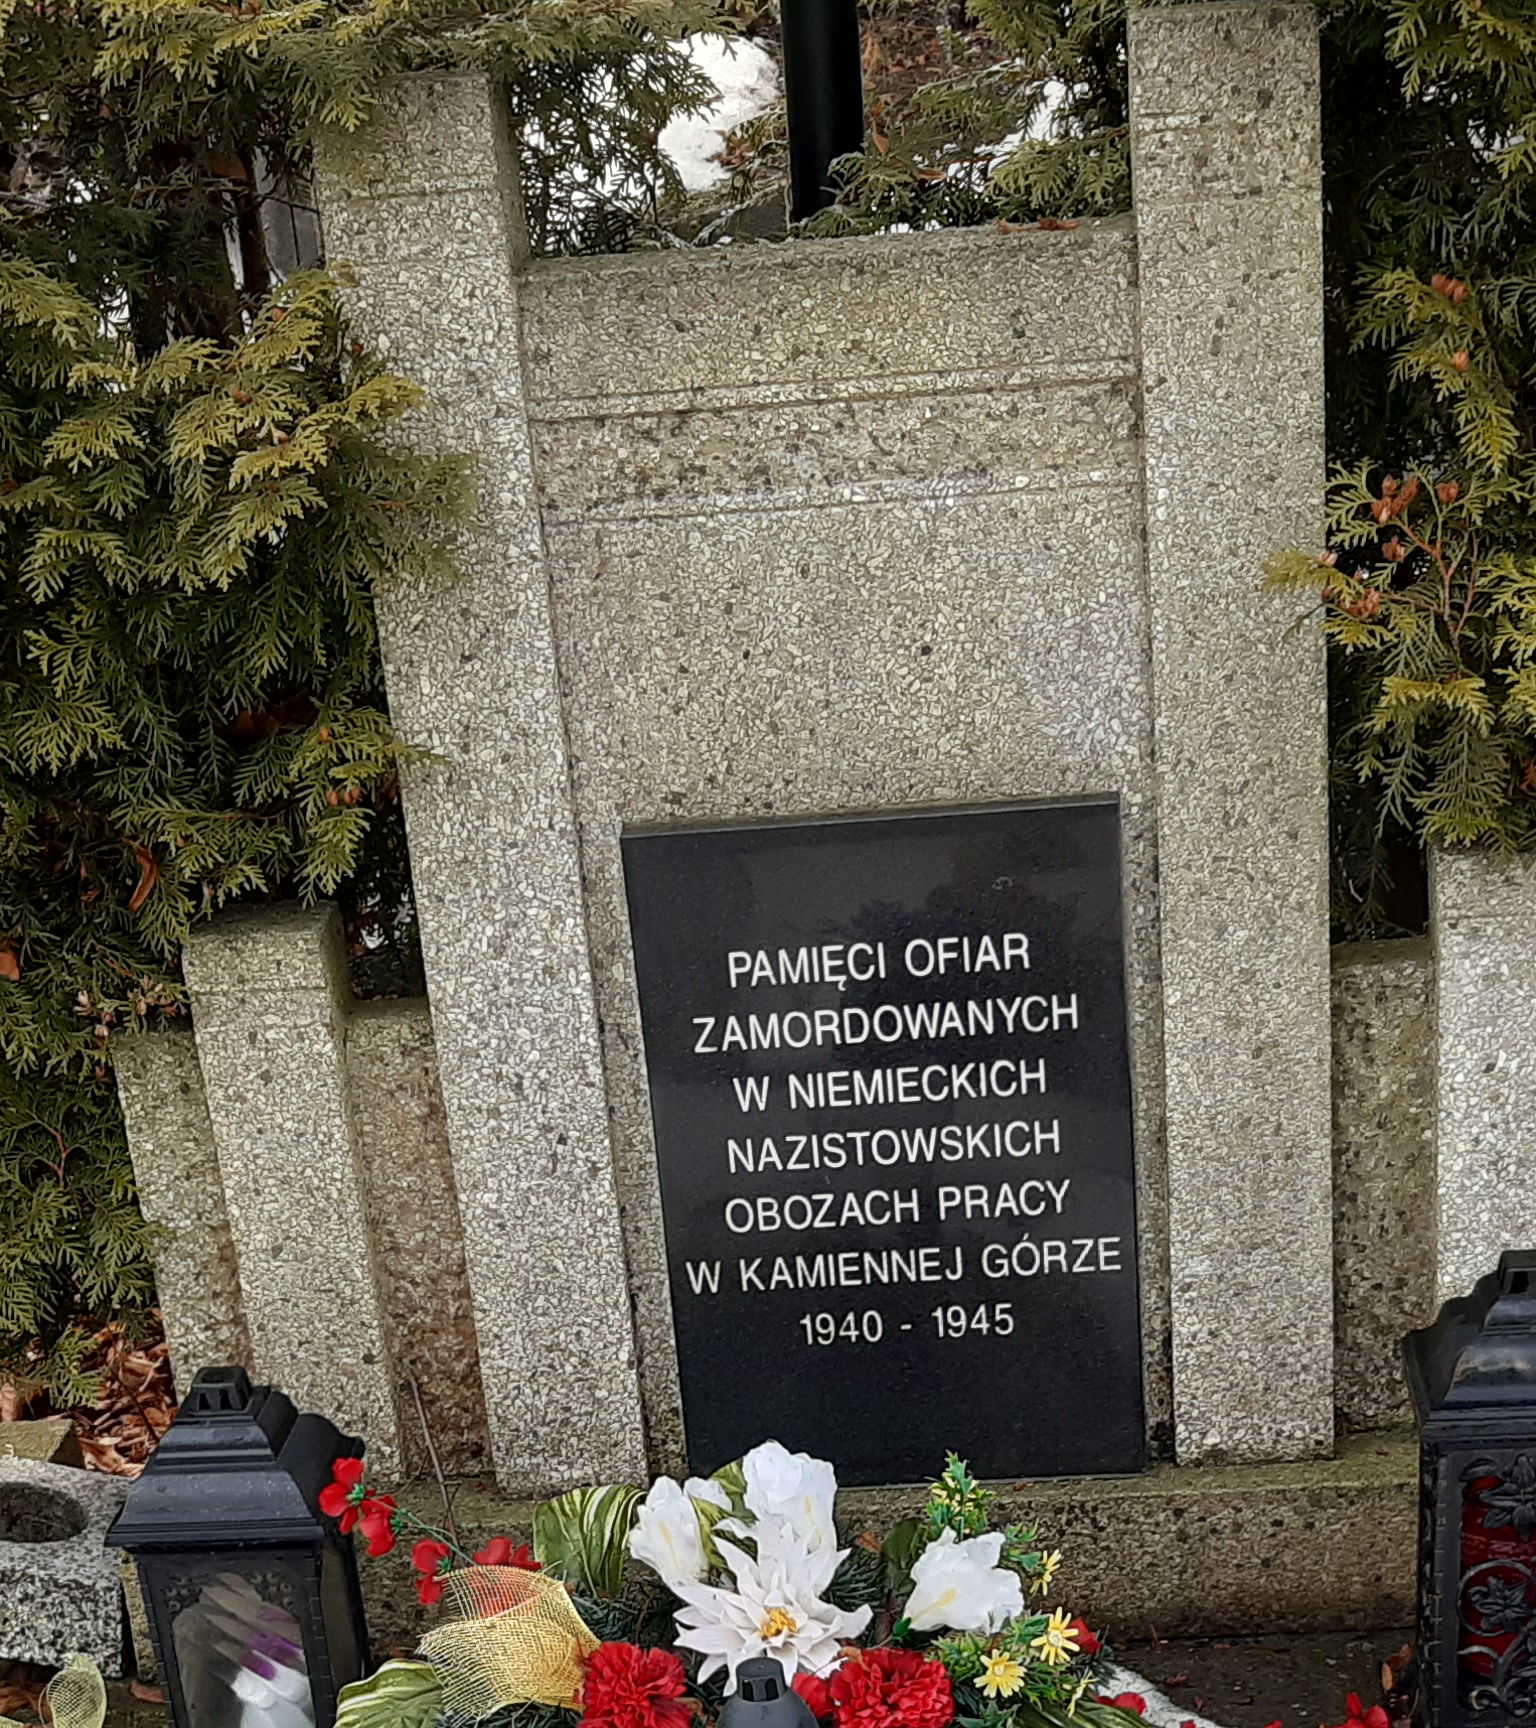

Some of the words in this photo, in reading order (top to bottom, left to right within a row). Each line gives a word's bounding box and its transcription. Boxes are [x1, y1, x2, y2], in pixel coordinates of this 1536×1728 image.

[727, 941, 886, 992] PAMIĘCI
[904, 932, 1031, 977] OFIAR
[692, 993, 1078, 1054] ZAMORDOWANYCH
[732, 1075, 770, 1113] W
[788, 1058, 1046, 1110] NIEMIECKICH
[727, 1119, 1060, 1174] NAZISTOWSKICH
[725, 1188, 920, 1233] OBOZACH
[938, 1178, 1071, 1221] PRACY
[685, 1261, 721, 1295] W
[739, 1246, 963, 1292] KAMIENNEJ
[981, 1232, 1122, 1278] GÓRZE
[799, 1310, 883, 1345] 1940
[931, 1303, 1014, 1338] 1945
